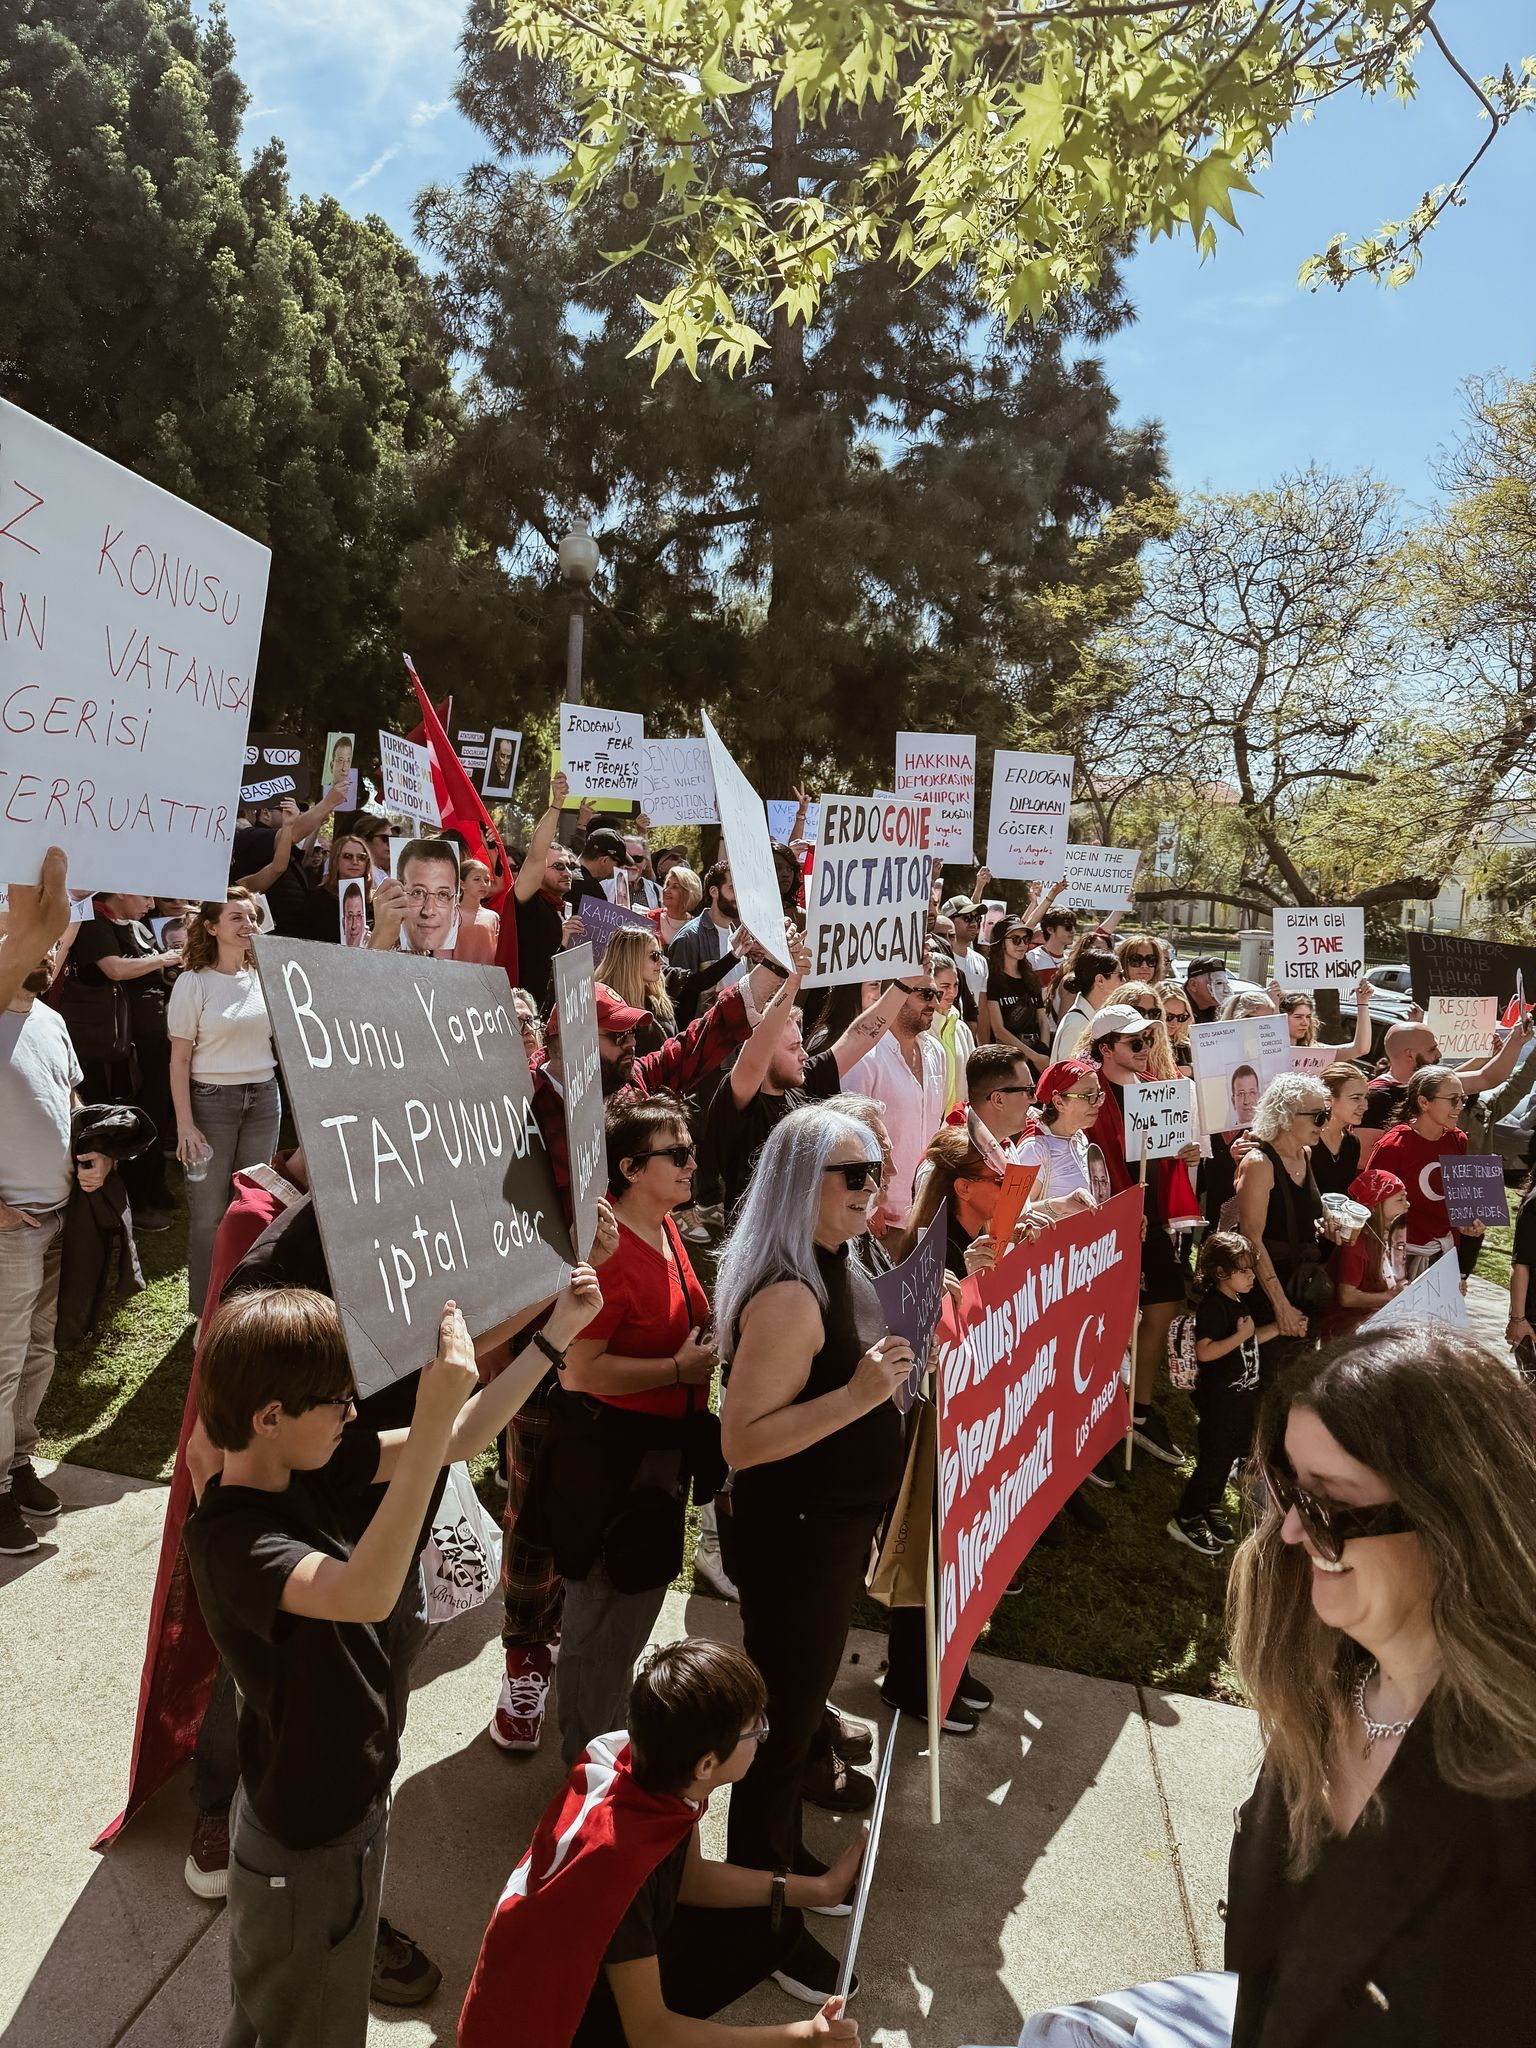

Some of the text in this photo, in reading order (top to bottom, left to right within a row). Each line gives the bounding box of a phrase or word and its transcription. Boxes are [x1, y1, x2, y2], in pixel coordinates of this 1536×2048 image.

[98, 525, 241, 626] KONUSU
[382, 735, 415, 759] TURKISH
[607, 737, 633, 751] FEAR
[264, 750, 298, 763] YOK
[905, 752, 973, 771] HAKKINA
[568, 760, 640, 777] THE PEOPLE'S
[239, 777, 295, 800] BAŞINA
[386, 767, 423, 795] IS UNDER
[584, 775, 639, 790] STRENGTH
[674, 776, 706, 787] WHEN
[387, 787, 424, 812] CUSTODY
[642, 794, 708, 815] OPPOSITION
[824, 804, 932, 850] ERDOGONE
[1088, 852, 1099, 862] IN
[1104, 853, 1124, 864] THE
[819, 854, 933, 907] DICTATOR
[1071, 881, 1092, 891] ONE
[1068, 897, 1096, 908] DEVIL
[1286, 913, 1346, 927] BİZİM GİBİ
[816, 909, 928, 976] ERDOGAN
[1297, 935, 1344, 956] 3 TANE
[1285, 960, 1320, 979] İSTER
[1427, 968, 1482, 985] HALKA
[282, 960, 514, 1070] Bunu Yapan
[1438, 998, 1489, 1017] RESIST
[1454, 1019, 1478, 1031] FOR
[1472, 1186, 1485, 1199] DE
[374, 1200, 546, 1326] iptal eder
[1012, 1267, 1040, 1350] yok
[1039, 1250, 1065, 1315] tek
[1075, 1416, 1090, 1457] Los
[956, 1406, 1002, 1499] hep
[430, 1584, 473, 1610] Bristol
